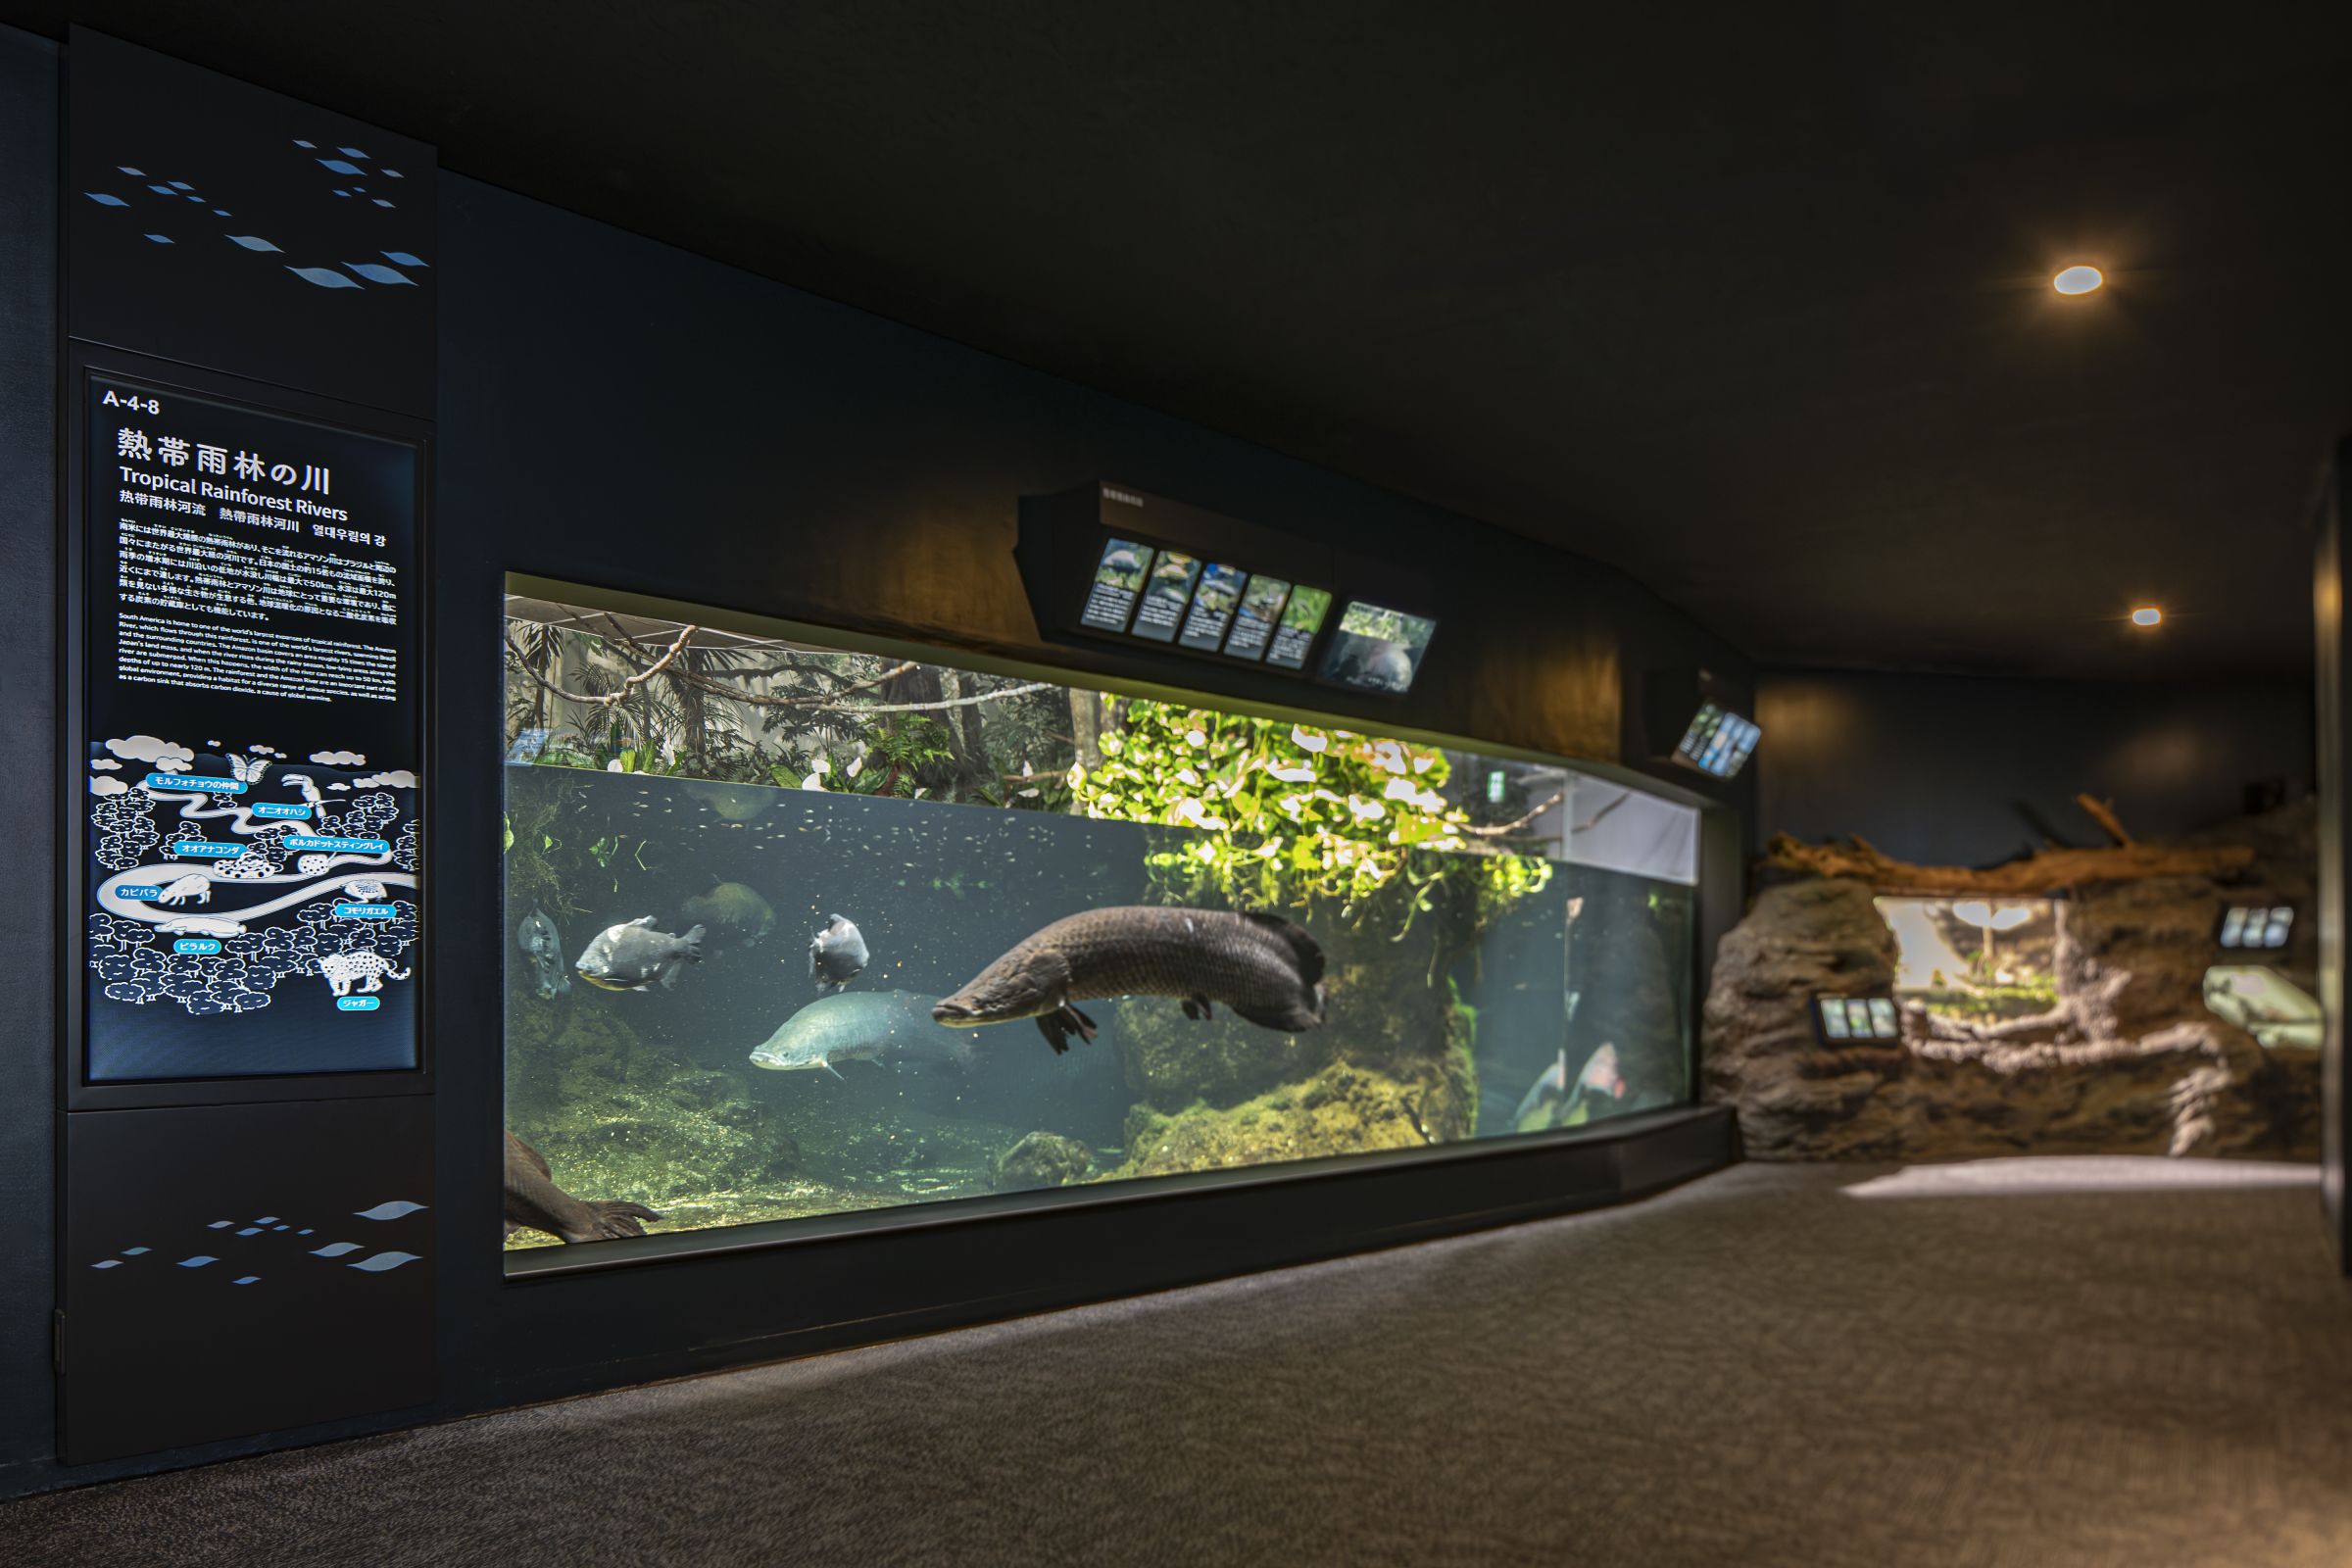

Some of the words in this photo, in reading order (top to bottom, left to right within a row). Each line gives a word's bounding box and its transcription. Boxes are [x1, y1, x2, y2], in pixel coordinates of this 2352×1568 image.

[103, 390, 160, 415] A-4-8
[117, 426, 330, 495] 熱帯雨林の川
[119, 466, 197, 495] Tropical
[201, 481, 293, 512] Rainforest
[296, 499, 348, 522] Rivers
[120, 489, 207, 517] 热带雨林河流
[312, 523, 371, 545] 열대우림의
[373, 532, 387, 547] 강
[146, 635, 184, 644] surrounding
[119, 657, 141, 665] depths
[149, 652, 186, 661] submerged.
[154, 775, 240, 791] モルフォチョウの仲間
[257, 805, 306, 816] オニオオハシ
[181, 843, 241, 856] オオアナコンダ
